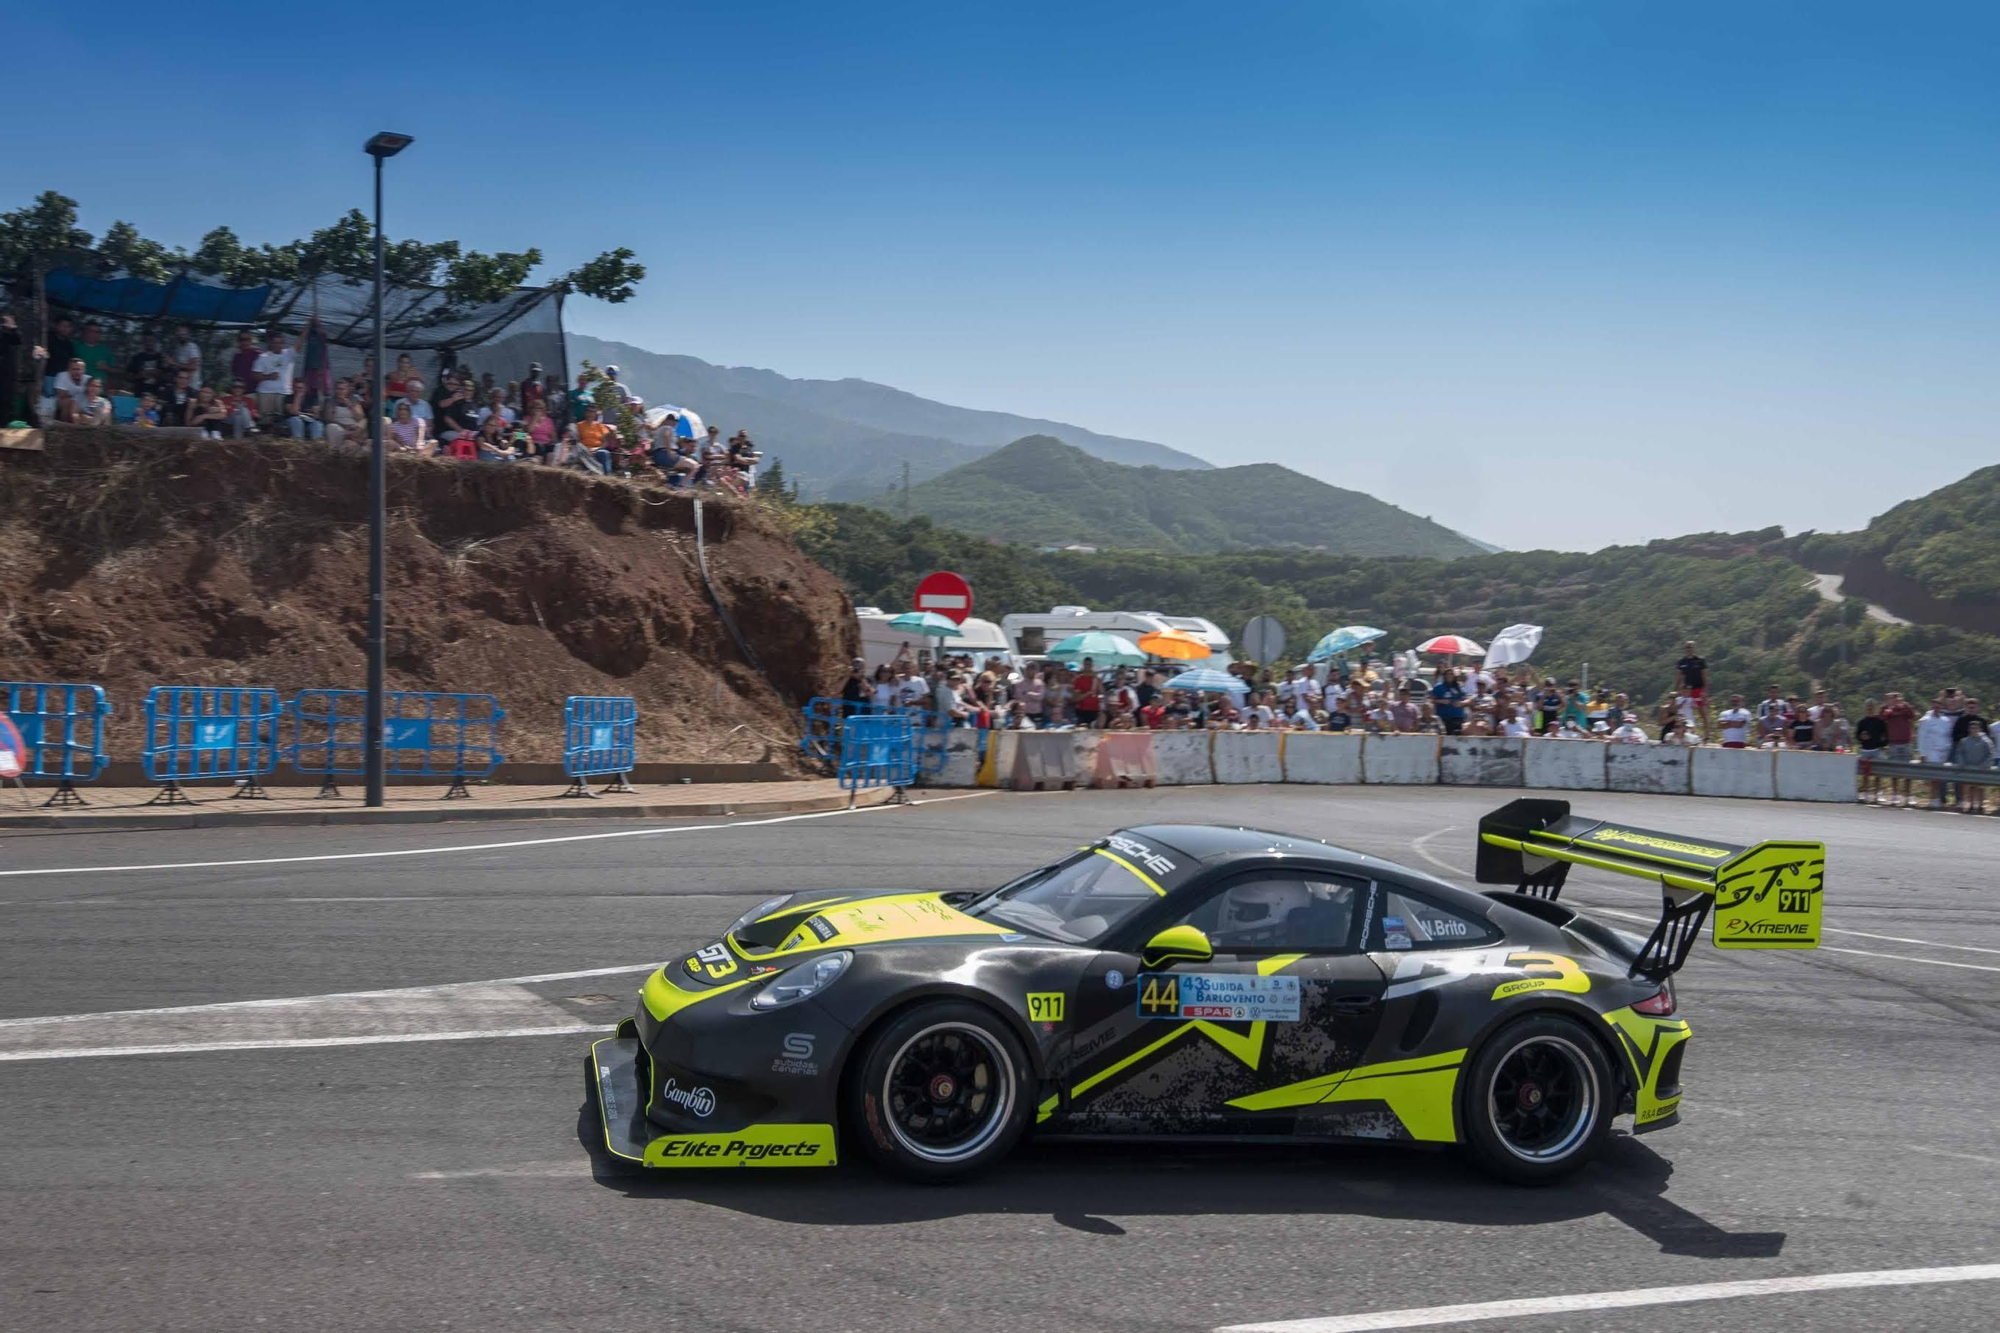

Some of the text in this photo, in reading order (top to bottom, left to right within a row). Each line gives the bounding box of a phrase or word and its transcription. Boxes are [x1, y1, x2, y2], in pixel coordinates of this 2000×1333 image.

[1780, 890, 1809, 912] 911
[1360, 880, 1378, 950] PORSCHE
[1141, 978, 1179, 1013] 44
[1196, 991, 1266, 1004] BARLOVENTO
[1502, 981, 1546, 994] GROUP
[1031, 996, 1062, 1018] 911
[1194, 1007, 1232, 1016] SPAR
[771, 1064, 818, 1076] canarias
[664, 1077, 716, 1118] Gambin
[661, 1140, 821, 1160] Elite Projects
